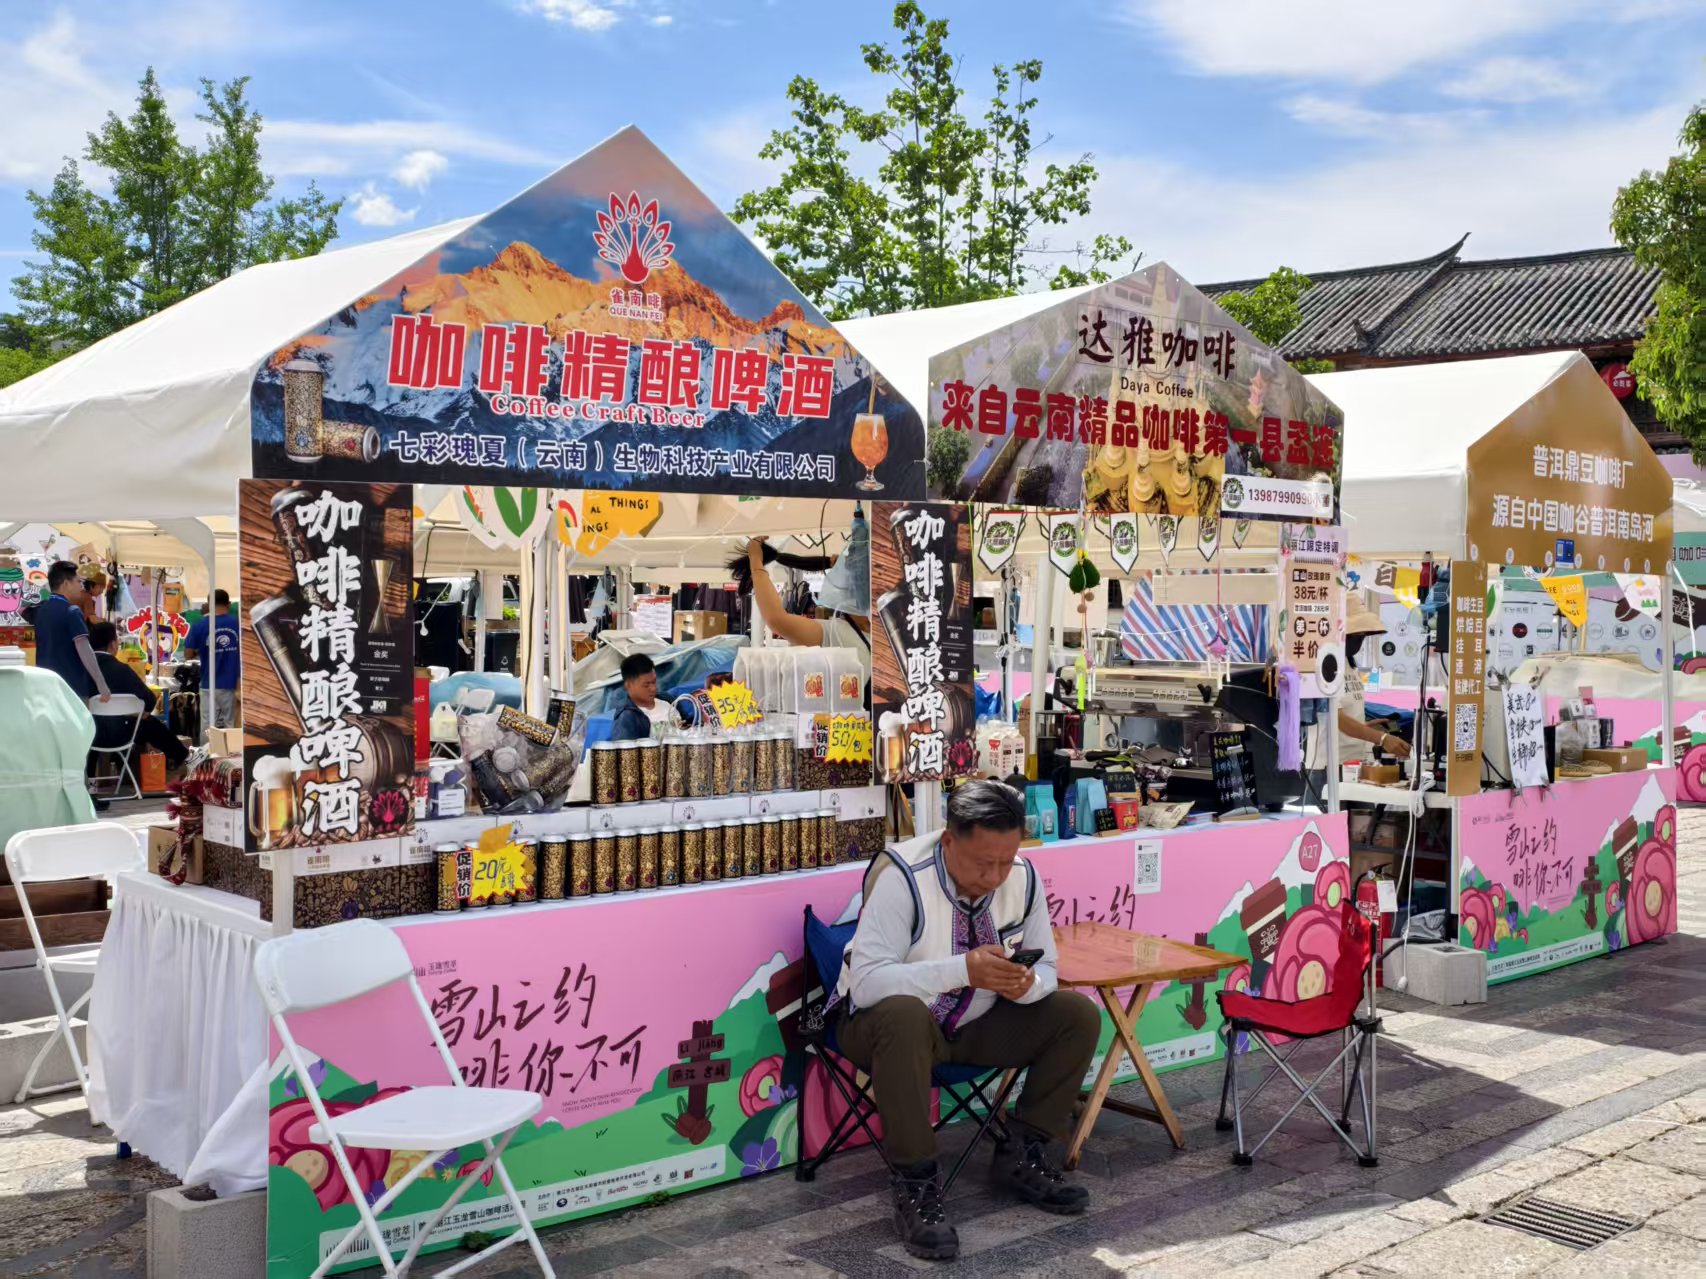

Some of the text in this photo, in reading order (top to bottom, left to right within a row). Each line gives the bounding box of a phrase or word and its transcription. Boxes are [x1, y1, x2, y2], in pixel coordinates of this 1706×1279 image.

[610, 288, 661, 308] 雀南啡
[609, 307, 663, 321] QUE NAN FEI
[1078, 310, 1237, 379] 达雅咖啡
[388, 314, 834, 418] 咖啡精酿啤酒
[1121, 376, 1194, 398] Daya Coffee
[491, 395, 706, 428] Coffee Craft Beer
[1533, 444, 1634, 488] 普洱鼎豆咖啡厂
[609, 497, 649, 510] THINGS
[583, 522, 609, 533] INGS
[1492, 494, 1655, 543] 源自中国咖谷普洱南岛河
[1294, 586, 1329, 600] 38元/杯
[1295, 617, 1330, 637] 第二杯
[905, 509, 946, 775] 咖啡精酿啤酒
[1293, 641, 1319, 660] 半价
[295, 490, 364, 837] 咖啡精酿啤酒
[698, 693, 720, 729] 促销价
[1301, 844, 1319, 859] A27
[457, 851, 471, 897] 促销价
